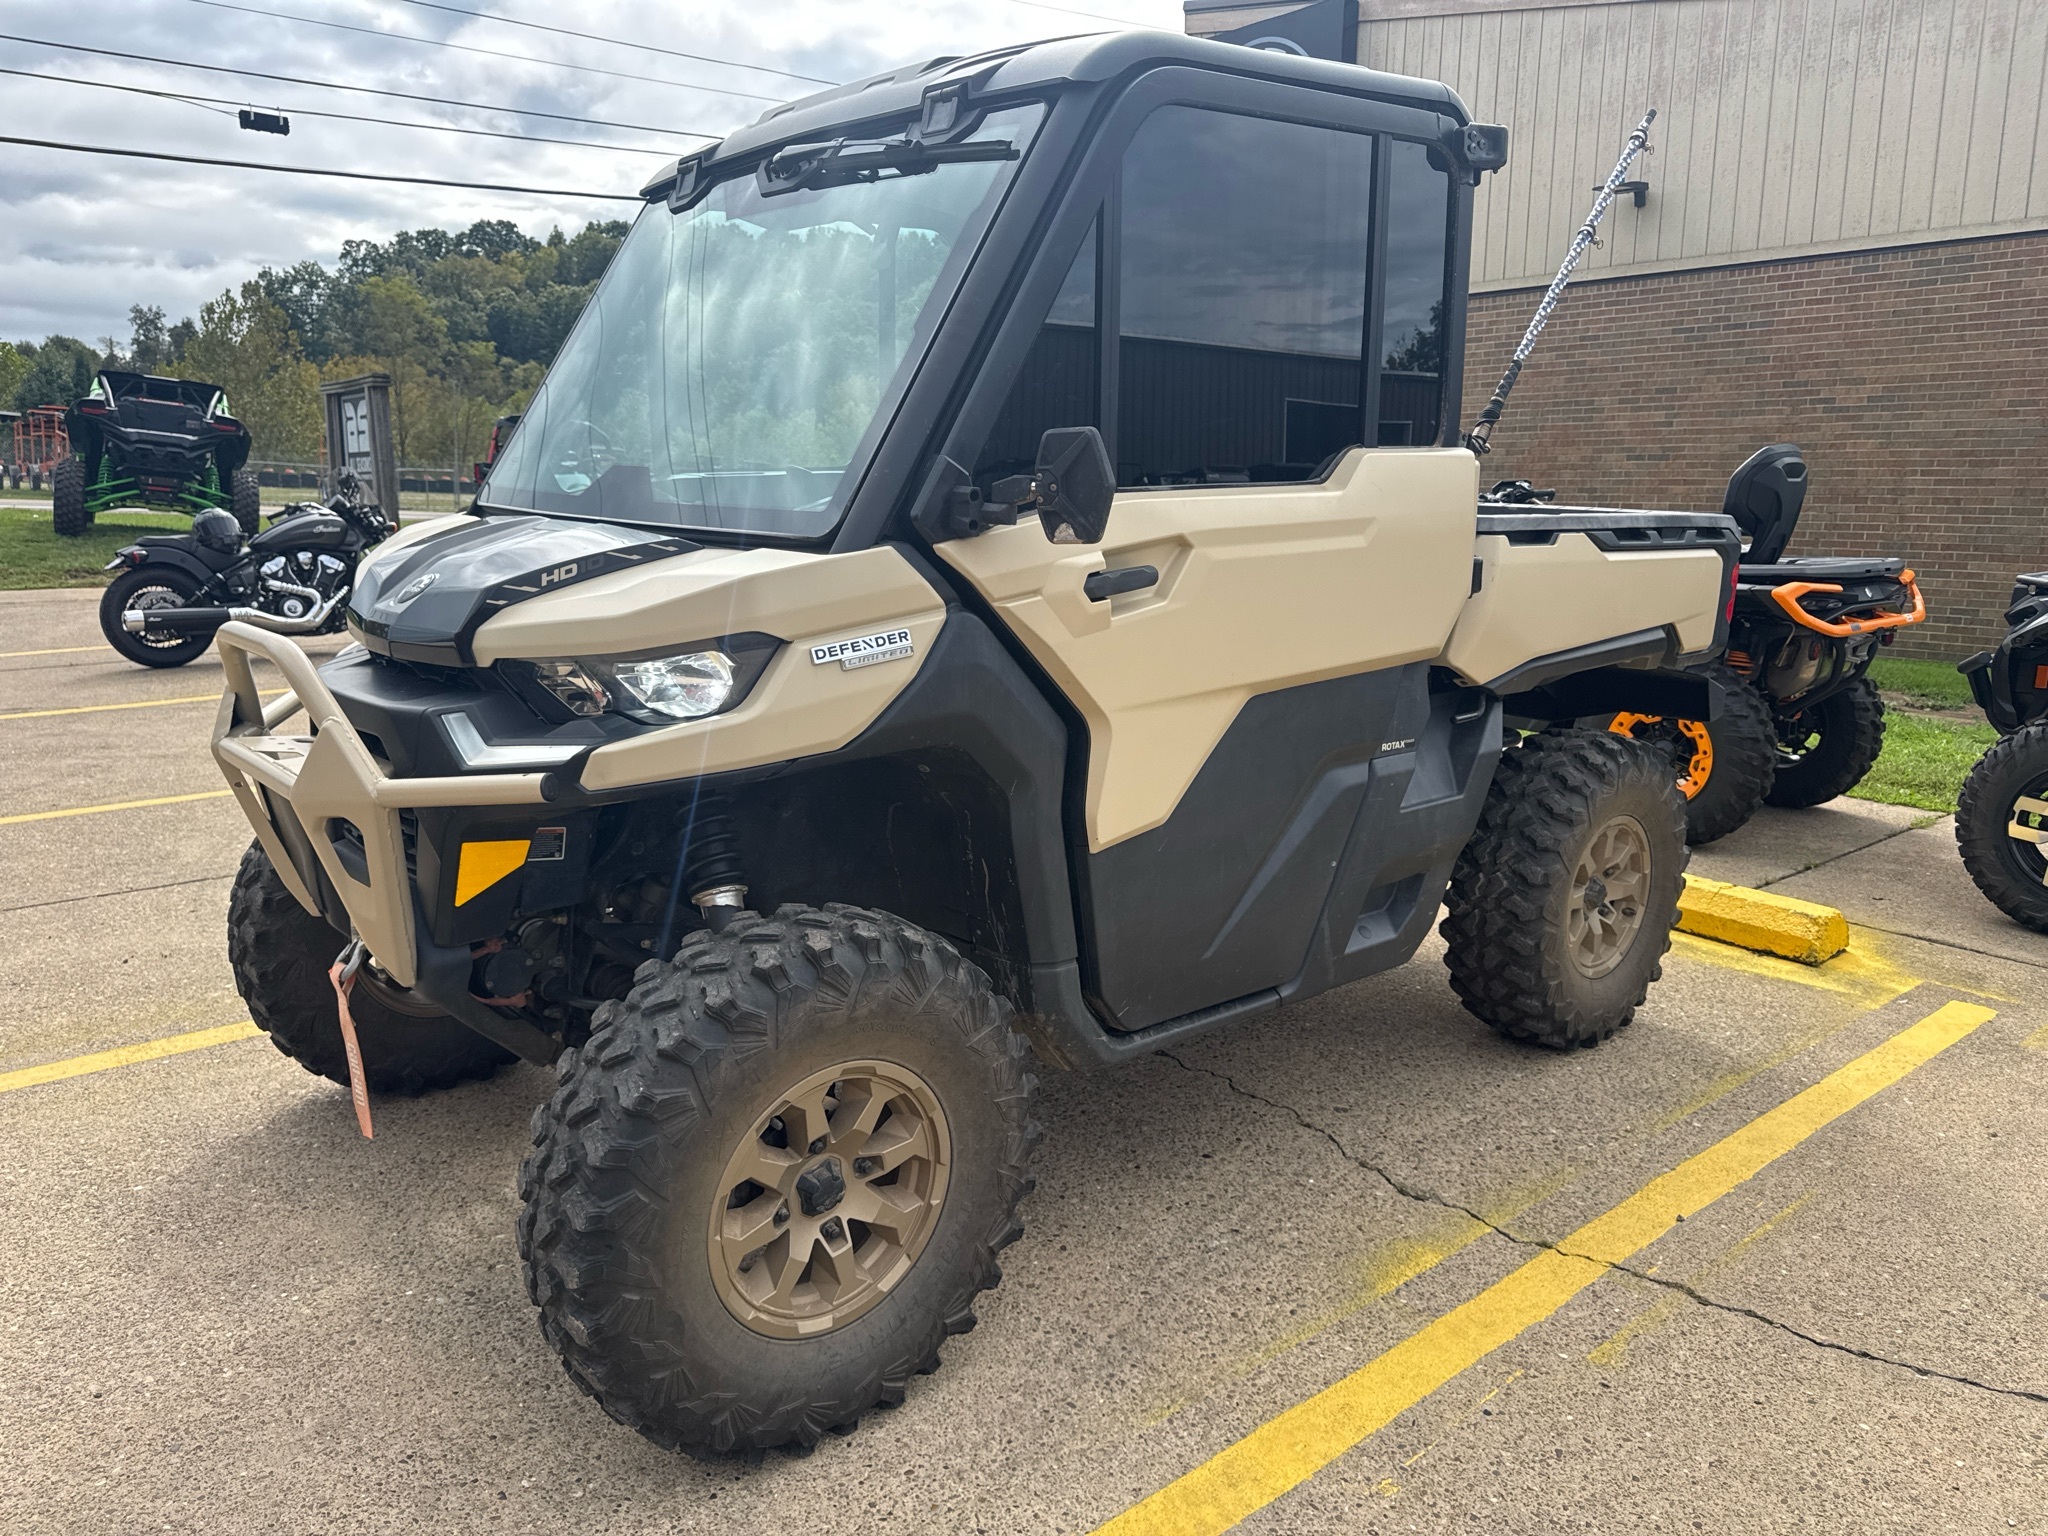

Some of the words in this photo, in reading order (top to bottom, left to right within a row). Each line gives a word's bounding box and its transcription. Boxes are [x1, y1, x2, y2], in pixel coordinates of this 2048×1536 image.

[814, 631, 909, 660] DEFENDER
[848, 647, 909, 666] LIMITED
[1381, 740, 1406, 752] ROTAX
